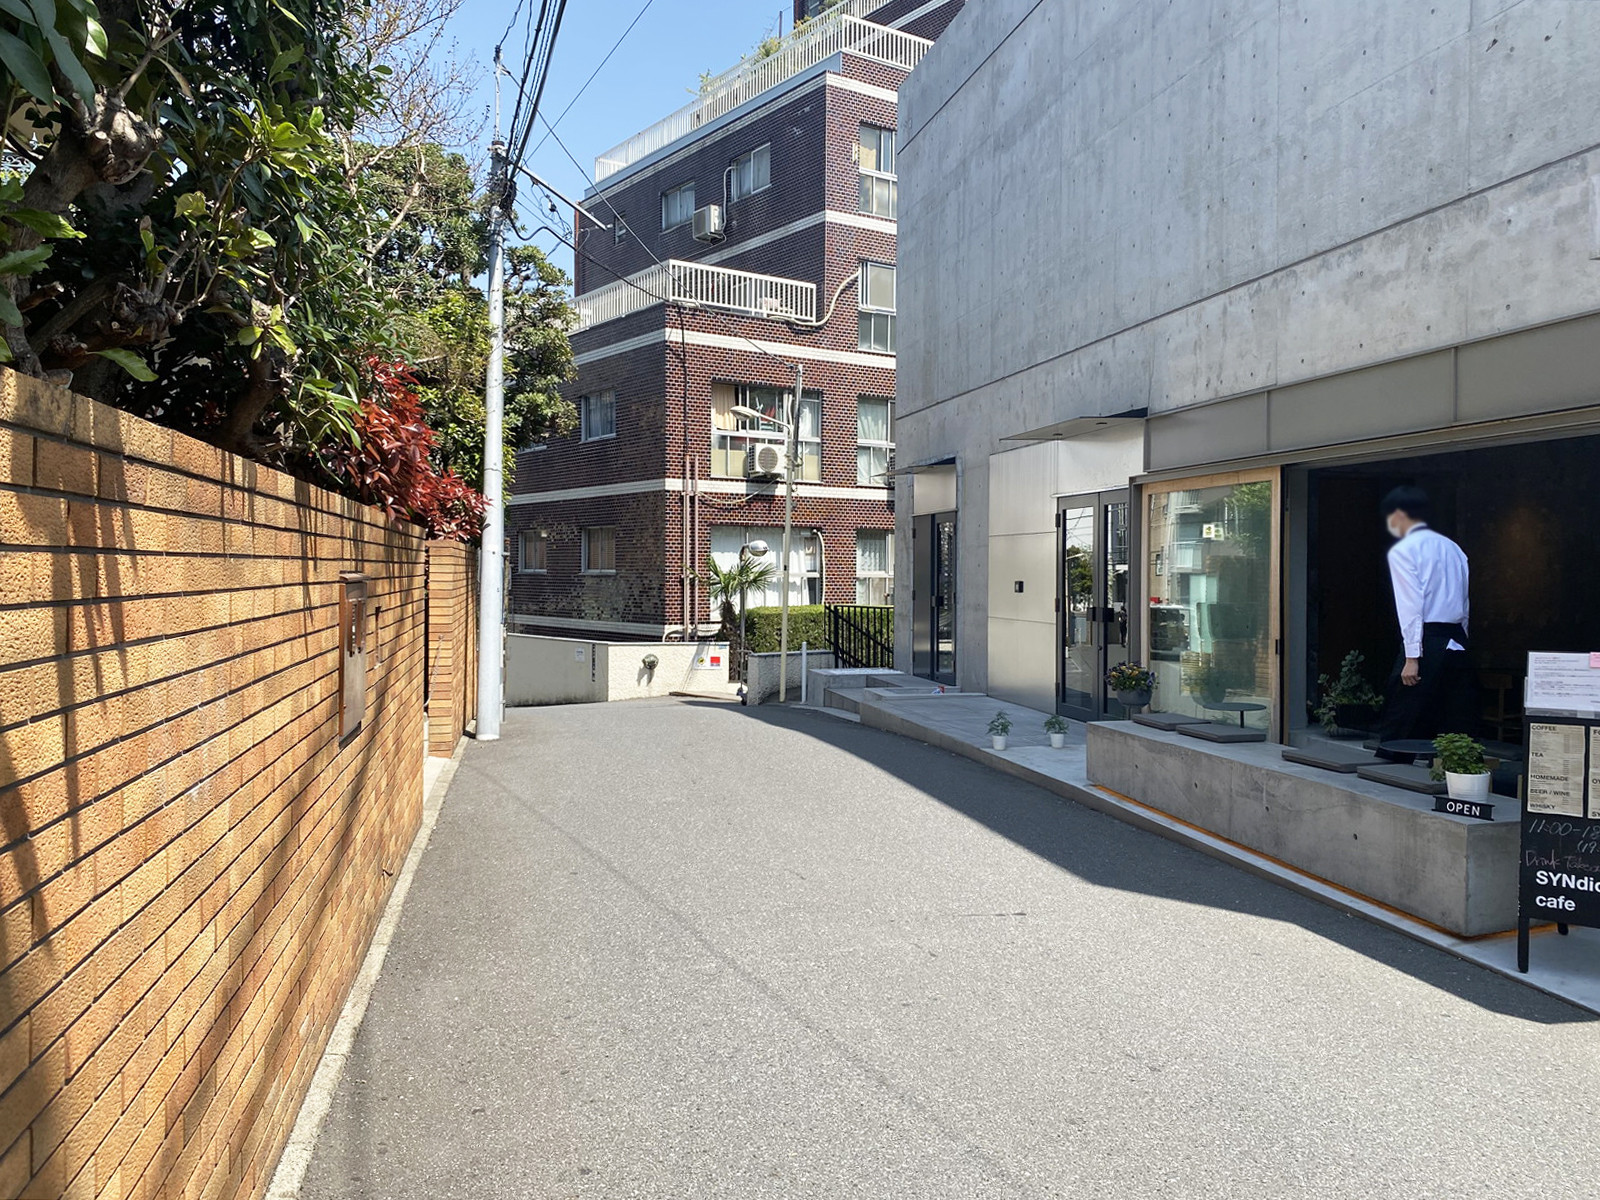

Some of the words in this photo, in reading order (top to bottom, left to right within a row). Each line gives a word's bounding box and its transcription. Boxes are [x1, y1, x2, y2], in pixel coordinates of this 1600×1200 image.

[1530, 774, 1569, 782] HOMEMADE
[1446, 801, 1480, 816] OPEN
[1535, 895, 1576, 911] cafe
